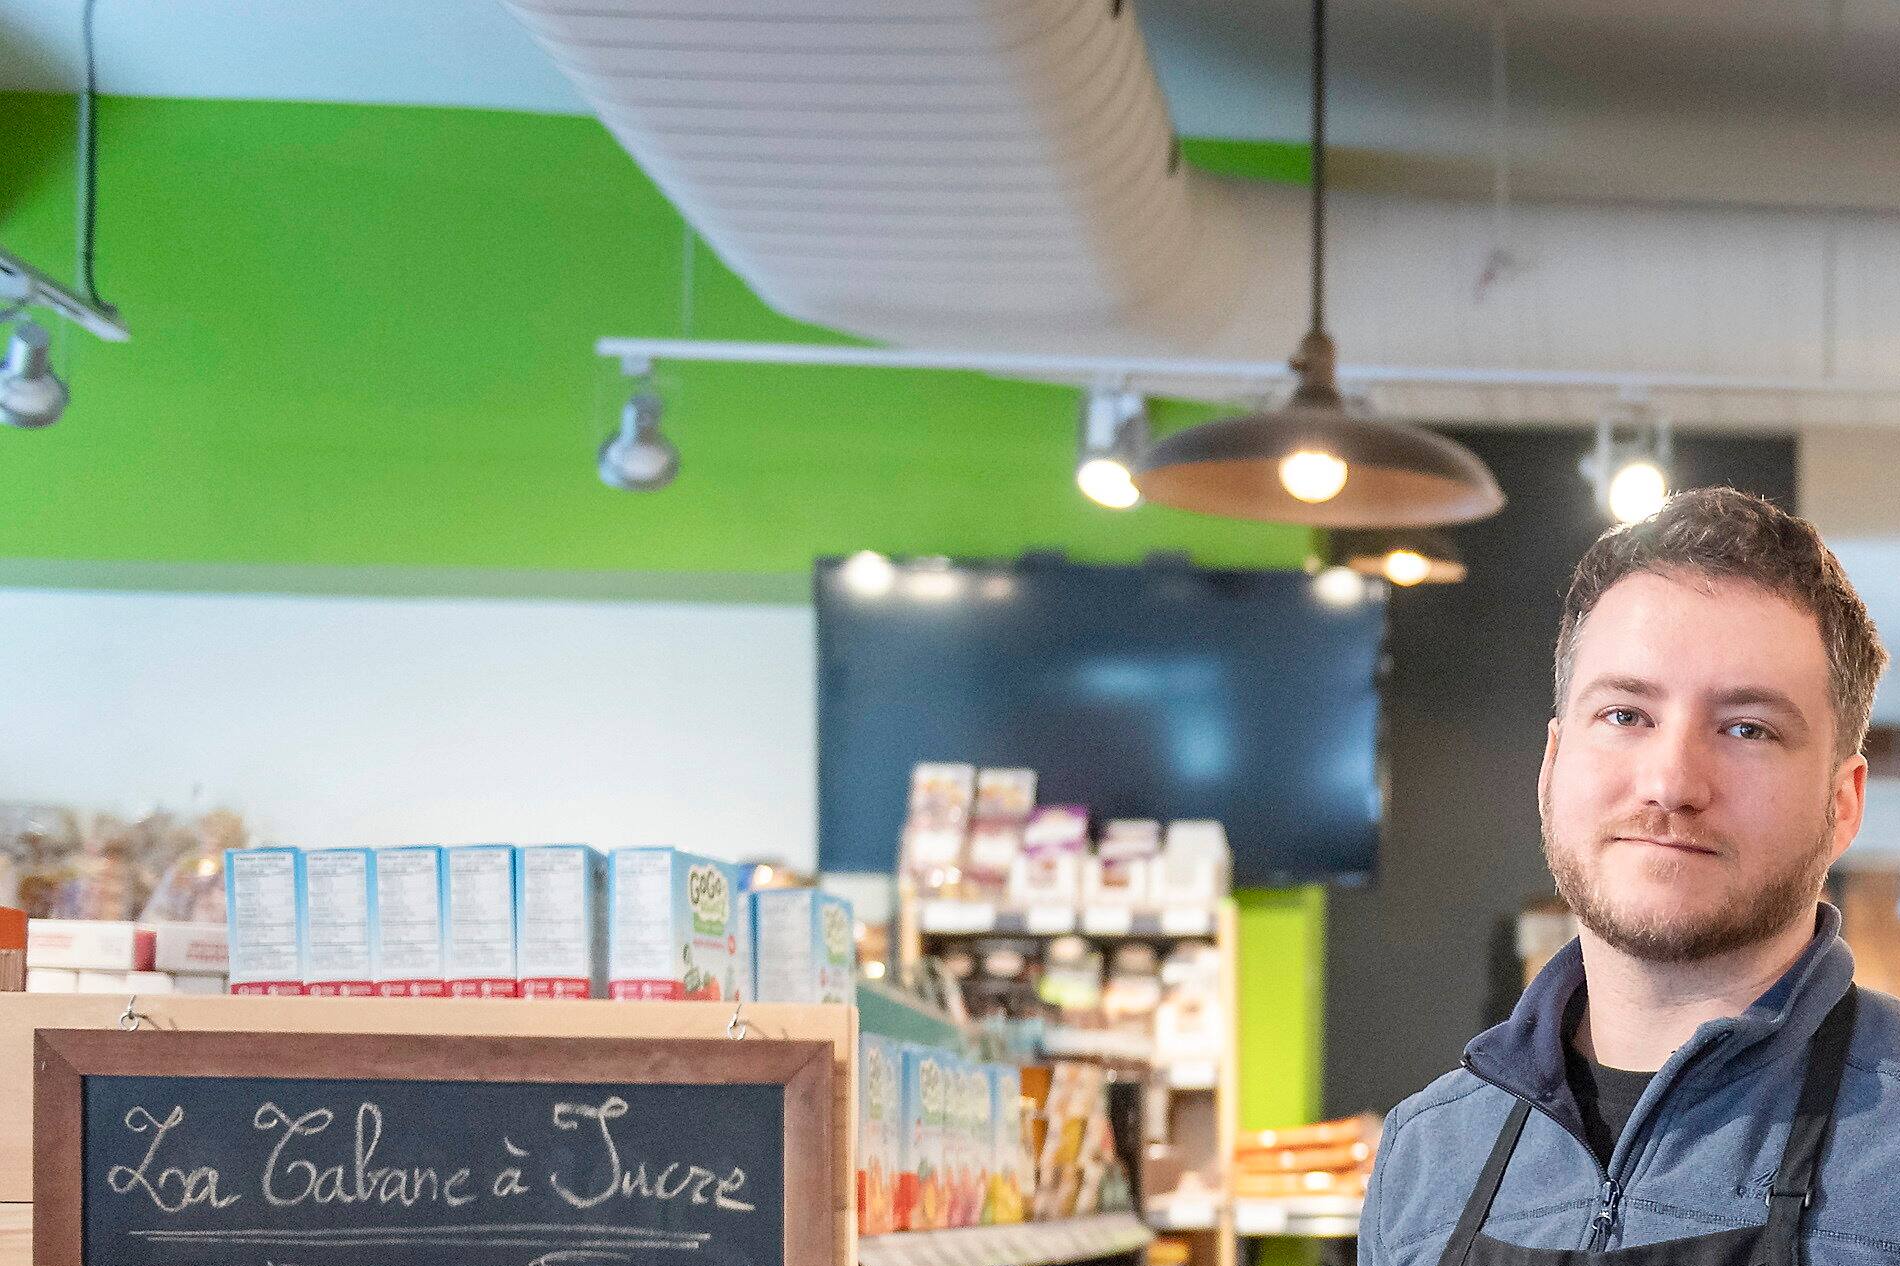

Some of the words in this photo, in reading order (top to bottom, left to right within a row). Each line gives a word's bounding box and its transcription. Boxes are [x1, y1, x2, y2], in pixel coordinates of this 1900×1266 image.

[107, 1104, 242, 1213] La
[253, 1101, 478, 1207] Cabane
[494, 1136, 528, 1198] à
[550, 1096, 757, 1211] Sucre
